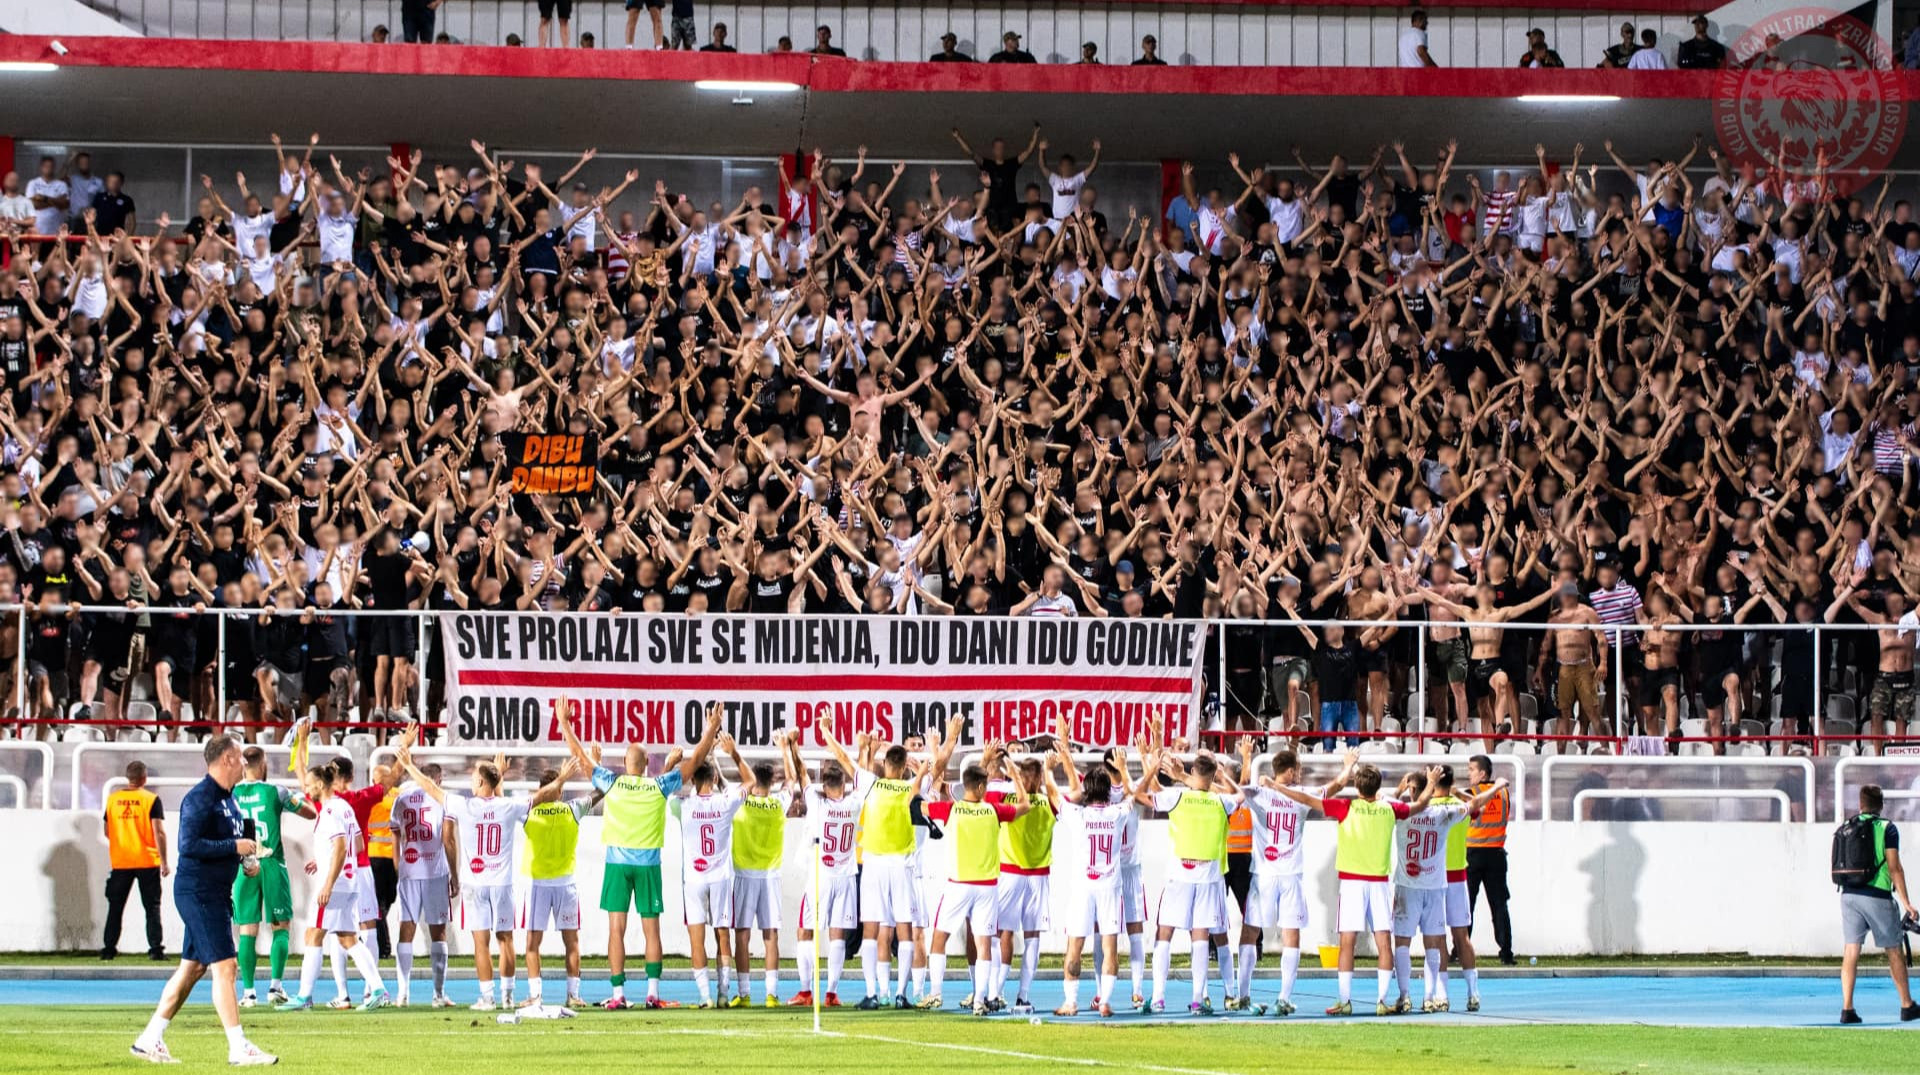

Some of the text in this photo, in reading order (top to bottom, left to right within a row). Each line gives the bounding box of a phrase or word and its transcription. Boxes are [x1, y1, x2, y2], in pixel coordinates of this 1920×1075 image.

[523, 434, 584, 464] DIBU
[456, 614, 1195, 668] SVE PROLAZI SVE SE MIJENJA, IDU DANI IDU GODINE
[458, 696, 540, 741] SAMO
[548, 698, 675, 744] ZRINJSKI
[795, 701, 893, 746] PONOS
[876, 781, 912, 792] macron
[403, 806, 433, 842] 25
[475, 823, 502, 856] 10
[700, 823, 715, 856] 6
[822, 821, 855, 853] 50
[1266, 811, 1297, 845] 44
[1088, 833, 1113, 866] 14
[1406, 828, 1438, 861] 20
